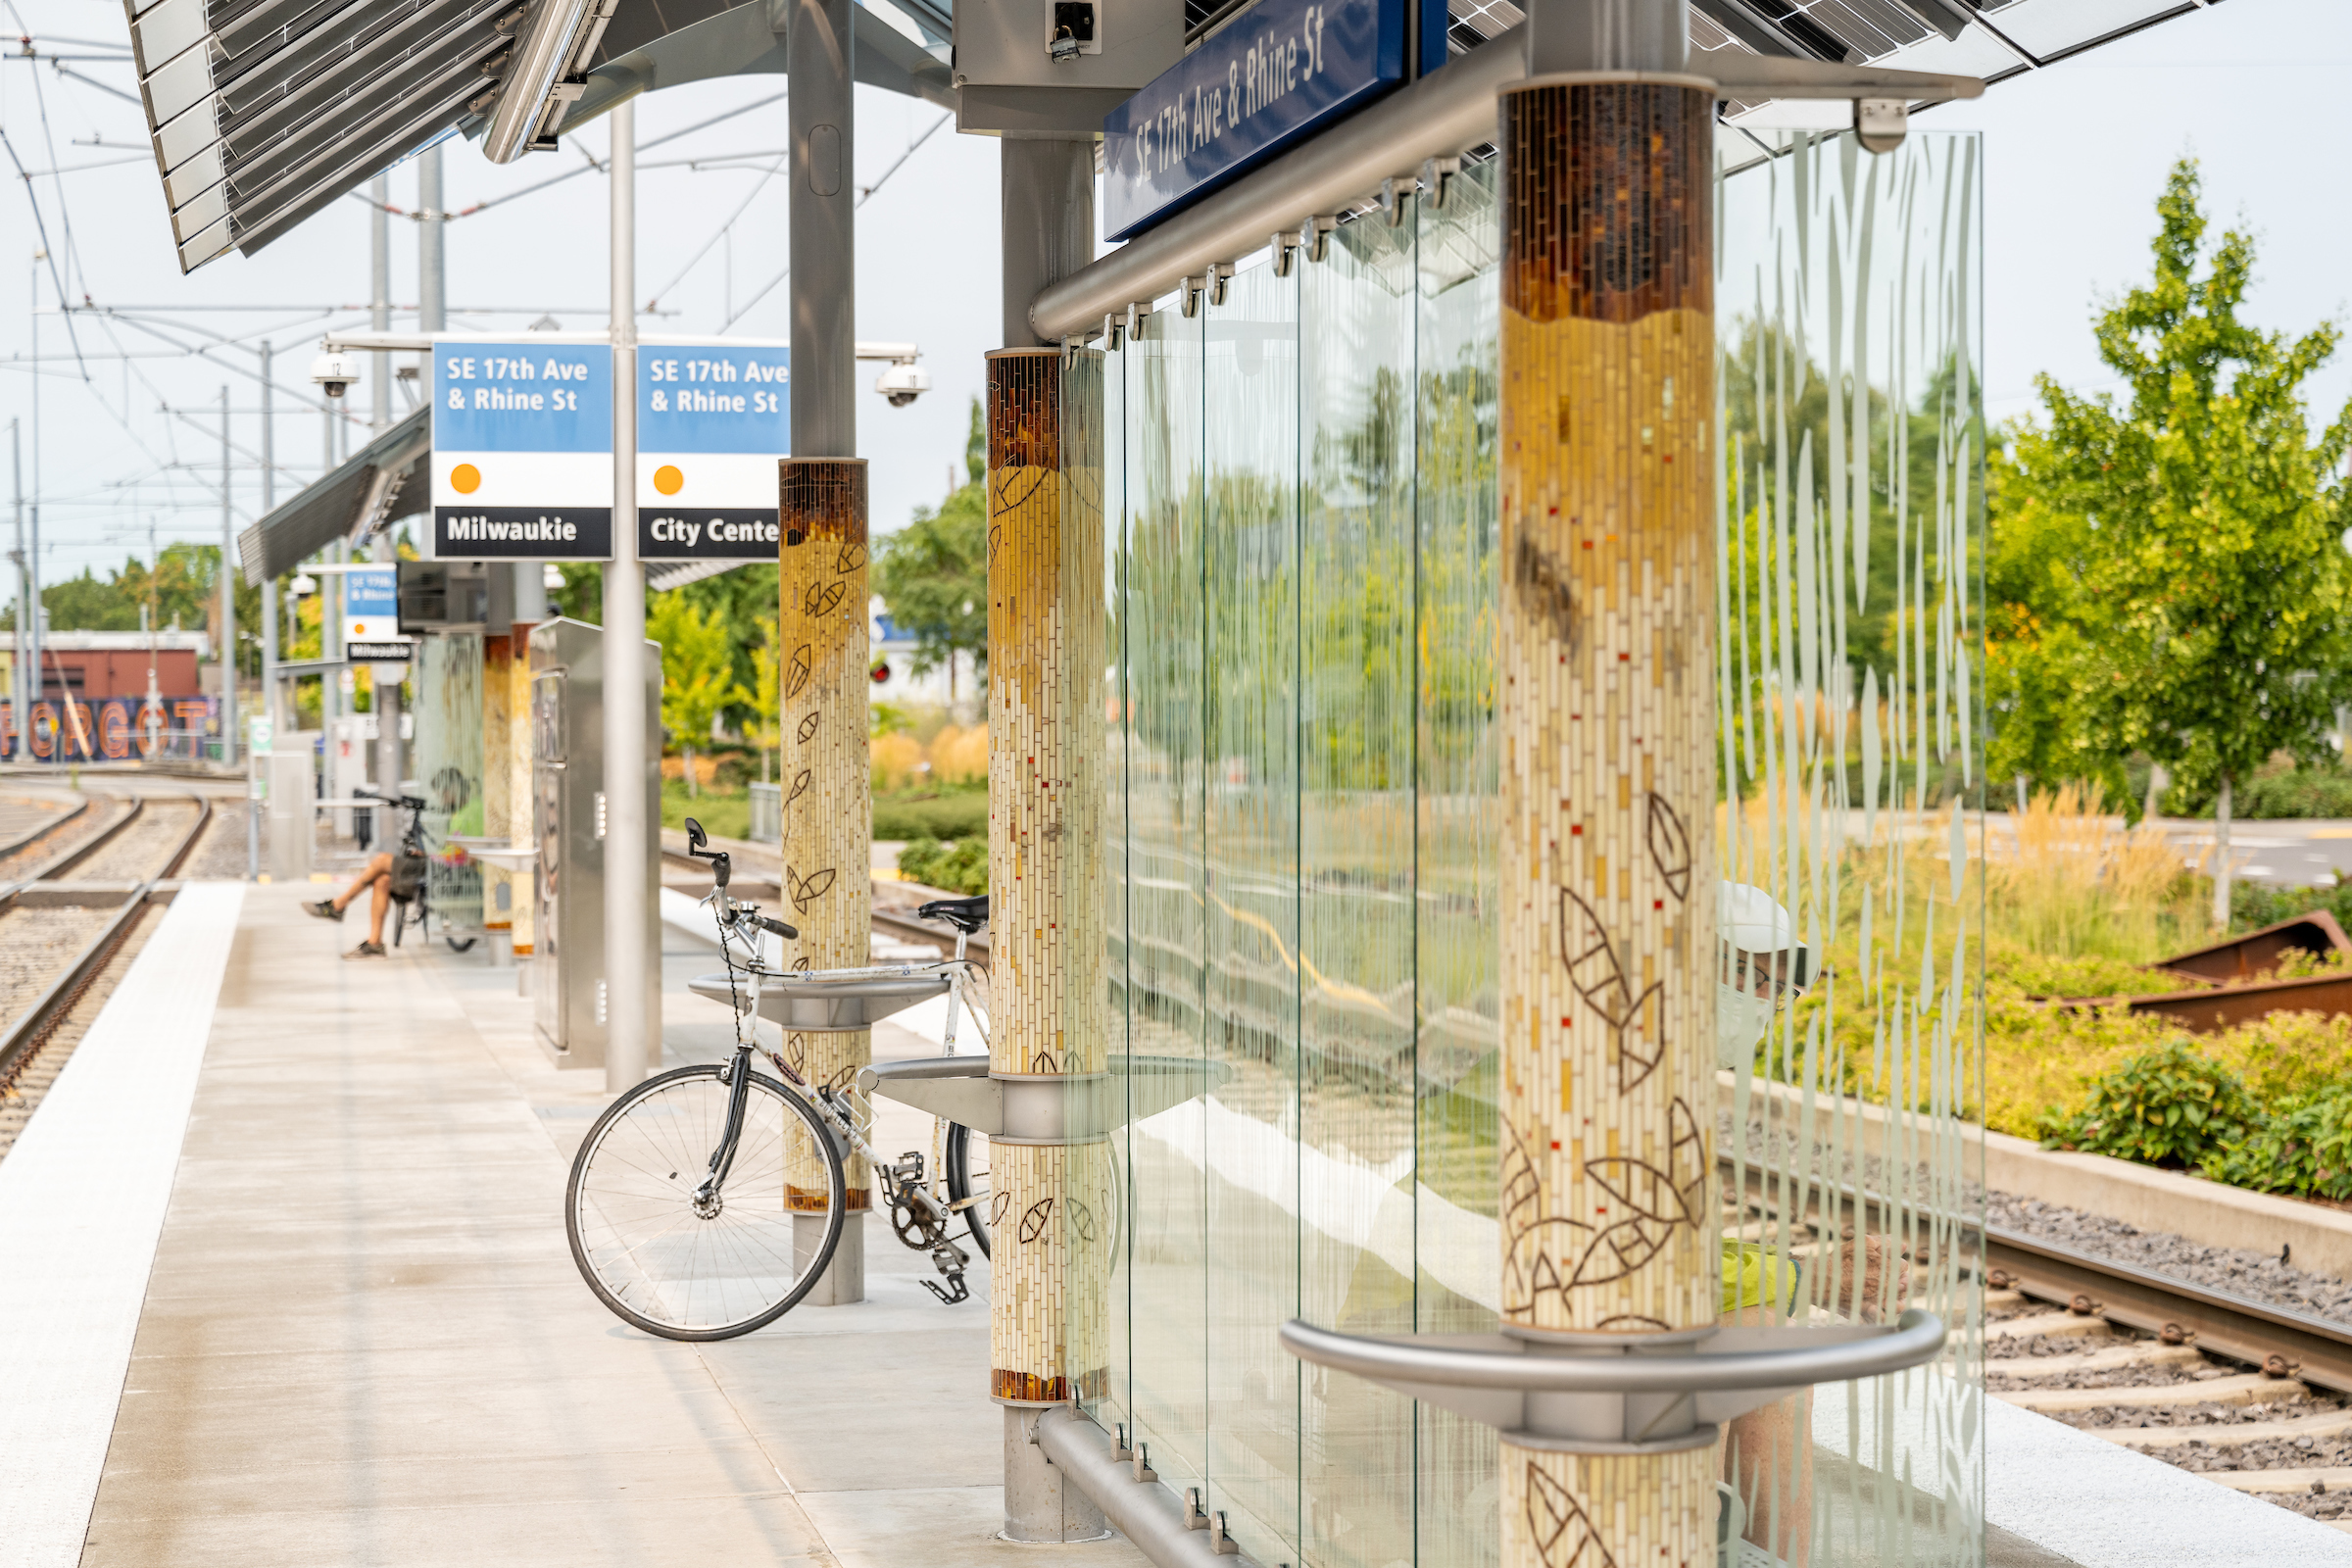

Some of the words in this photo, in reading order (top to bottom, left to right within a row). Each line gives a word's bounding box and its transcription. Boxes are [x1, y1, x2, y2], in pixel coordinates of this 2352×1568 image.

[1135, 119, 1152, 188] SE
[1156, 93, 1188, 174] 17th
[1192, 85, 1223, 153] Ave
[1227, 60, 1241, 129] &
[1246, 30, 1298, 119] Rhine
[1302, 4, 1325, 82] St
[447, 357, 476, 379] SE
[483, 357, 535, 380] 17th
[542, 358, 588, 381] Ave
[650, 359, 679, 381] SE
[686, 359, 736, 382] 17th
[744, 361, 789, 383] Ave
[447, 387, 466, 410] &
[474, 387, 544, 411] Rhine
[552, 388, 577, 412] St
[651, 389, 669, 412] &
[677, 389, 746, 413] Rhine
[754, 390, 779, 414] St
[447, 515, 577, 541] Milwaukie
[650, 516, 701, 547] City
[707, 517, 780, 542] Cente
[351, 643, 410, 658] Milwaukie
